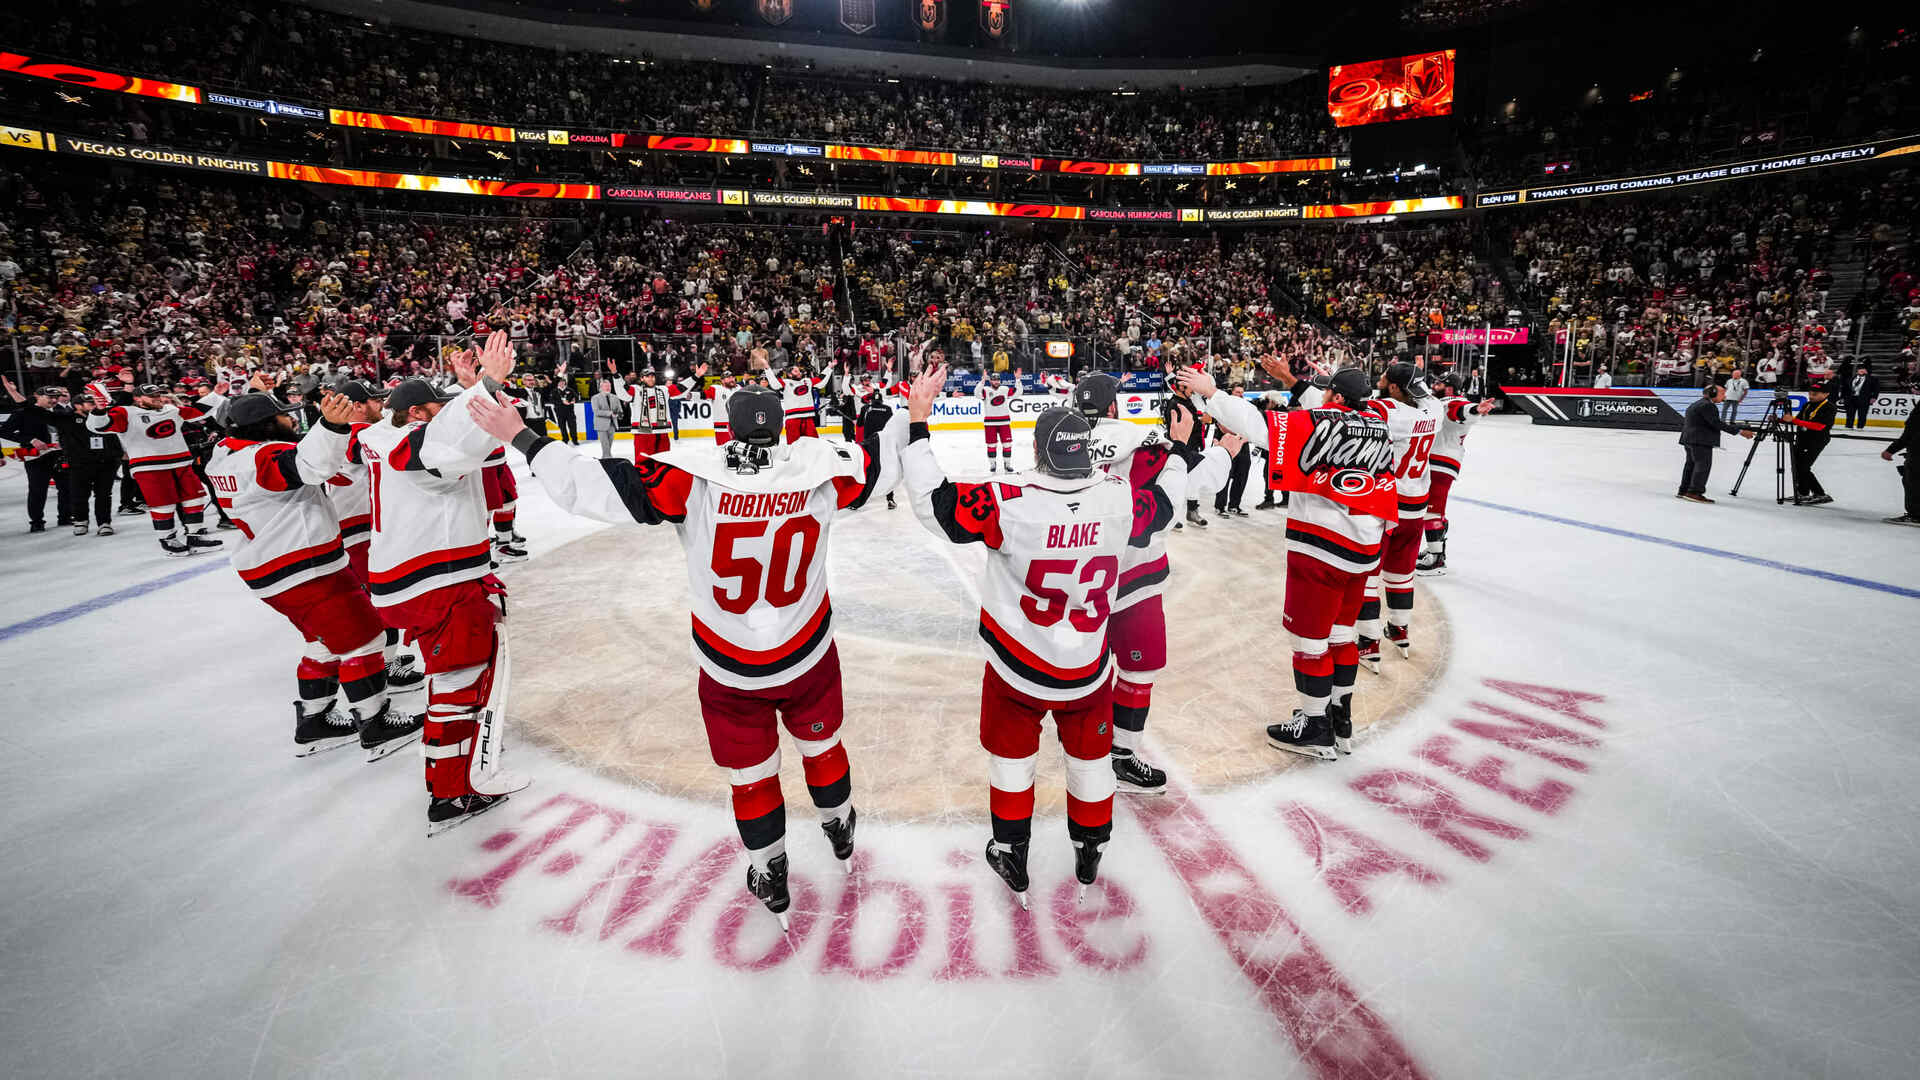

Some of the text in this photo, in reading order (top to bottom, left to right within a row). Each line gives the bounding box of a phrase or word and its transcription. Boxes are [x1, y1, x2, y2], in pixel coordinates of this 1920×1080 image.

[208, 94, 247, 107] STANLEY
[248, 100, 265, 109] CUP
[8, 131, 31, 143] VS
[518, 131, 546, 141] VEGAS
[570, 134, 609, 144] CAROLINA
[67, 139, 259, 172] VEGAS GOLDEN KNIGHTS
[958, 155, 980, 165] VEGAS
[1000, 159, 1030, 167] CAROLINA
[1531, 146, 1876, 199] THANK YOU FOR COMING, PLEASE GET HOME SAFELY!
[607, 188, 655, 199] CAROLINA
[656, 191, 712, 201] HURRICANES
[753, 193, 782, 204] VEGAS
[783, 195, 816, 206] GOLDEN
[818, 197, 853, 207] KNIGHTS
[1502, 193, 1517, 203] PM
[1090, 210, 1126, 218] CAROLINA
[1127, 211, 1173, 219] HURRICANES
[1207, 211, 1231, 219] VEGAS
[1232, 210, 1263, 219] GOLDEN
[1264, 208, 1299, 217] KNIGHTS
[933, 402, 981, 416] Mutual
[1595, 404, 1658, 414] CHAMPIONS
[1413, 418, 1437, 434] MILLER
[1276, 411, 1289, 465] DYARMOR
[1299, 419, 1394, 475] Champ
[1395, 434, 1436, 480] 19
[1312, 471, 1328, 485] 20
[1375, 478, 1394, 492] 26
[718, 490, 811, 518] ROBINSON
[1047, 522, 1101, 549] BLAKE
[711, 514, 821, 615] 50
[1019, 555, 1119, 633] 53
[480, 709, 494, 771] TRUE
[1275, 677, 1608, 916] ARENA
